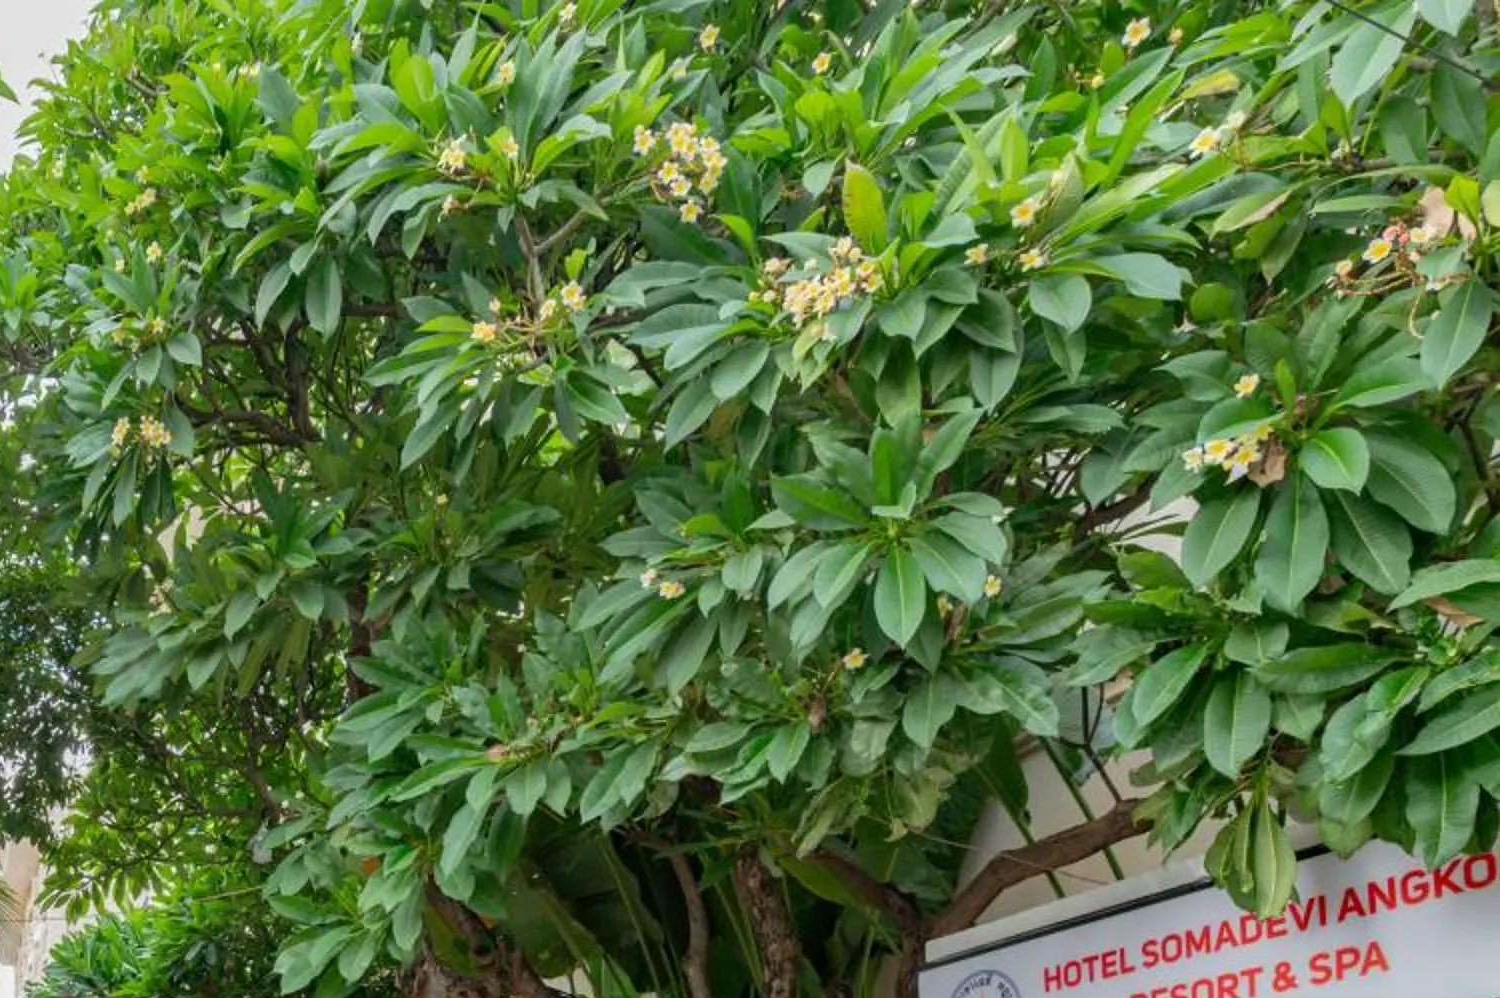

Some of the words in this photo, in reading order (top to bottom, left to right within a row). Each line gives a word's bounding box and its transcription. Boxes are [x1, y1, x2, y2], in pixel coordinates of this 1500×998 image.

[1043, 946, 1136, 992] HOTEL
[1140, 896, 1328, 969] SOMADEVI
[1337, 853, 1499, 923] ANGKO
[1272, 961, 1299, 992] &
[1309, 940, 1389, 985] SPA
